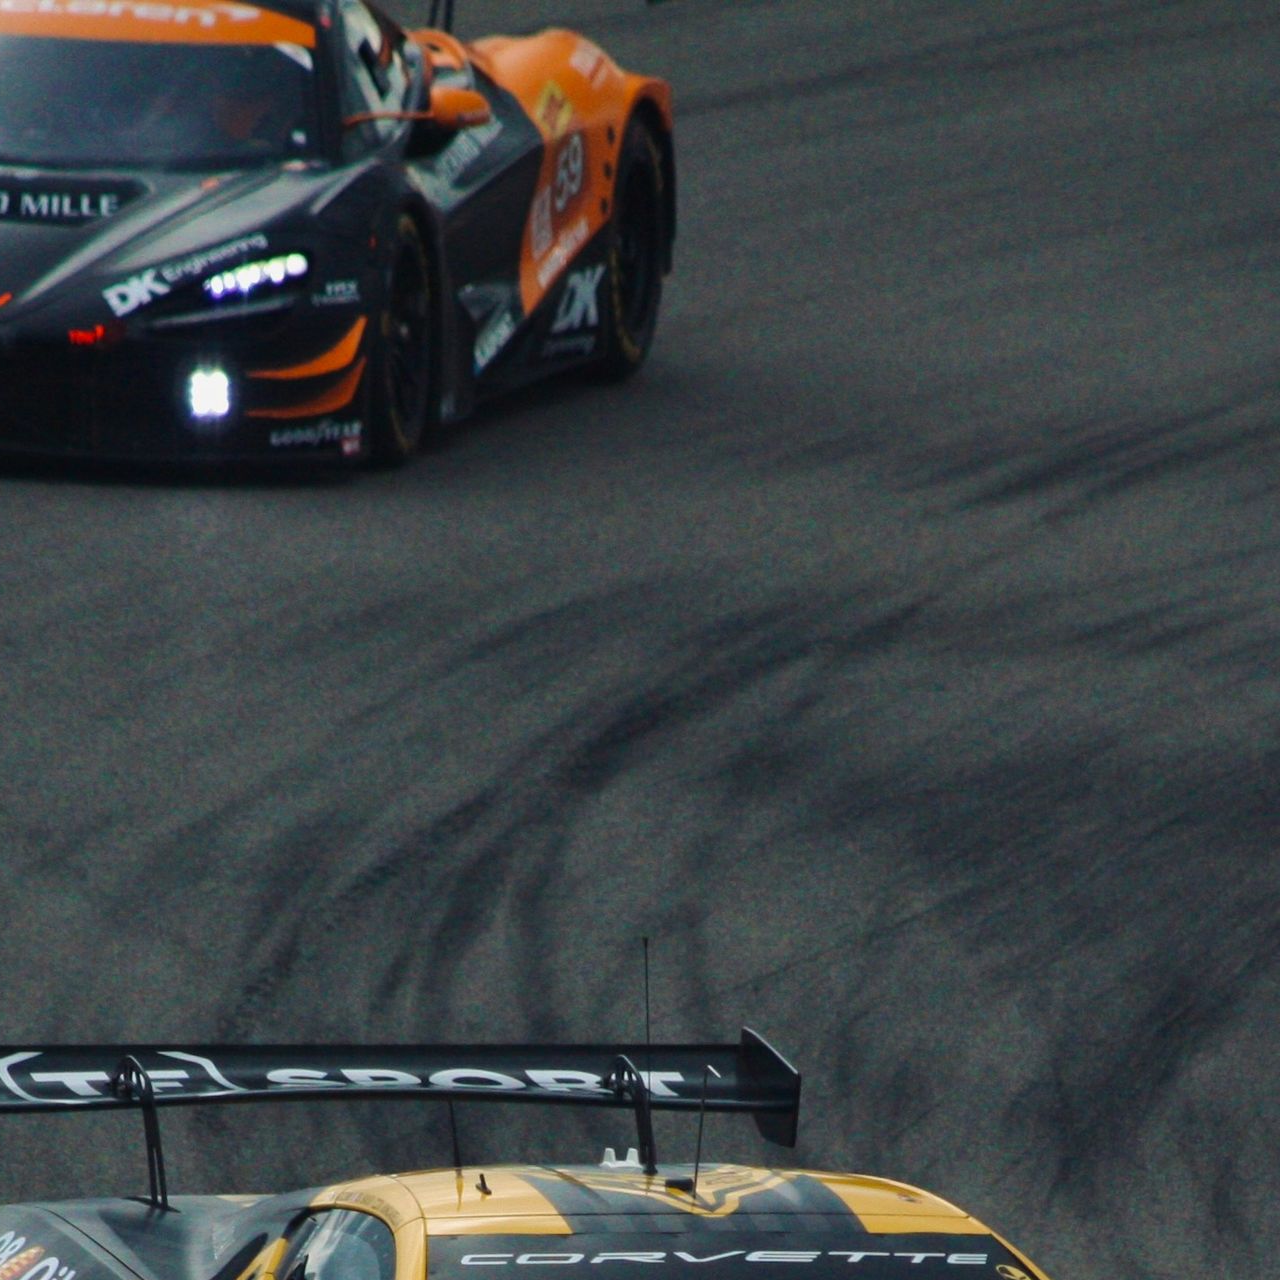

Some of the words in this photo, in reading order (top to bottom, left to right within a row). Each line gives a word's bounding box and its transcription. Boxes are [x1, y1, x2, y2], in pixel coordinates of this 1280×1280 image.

[20, 193, 119, 218] MILLE
[101, 268, 170, 317] DK
[266, 1067, 685, 1097] SPORT
[460, 1250, 989, 1265] CORVETTE
